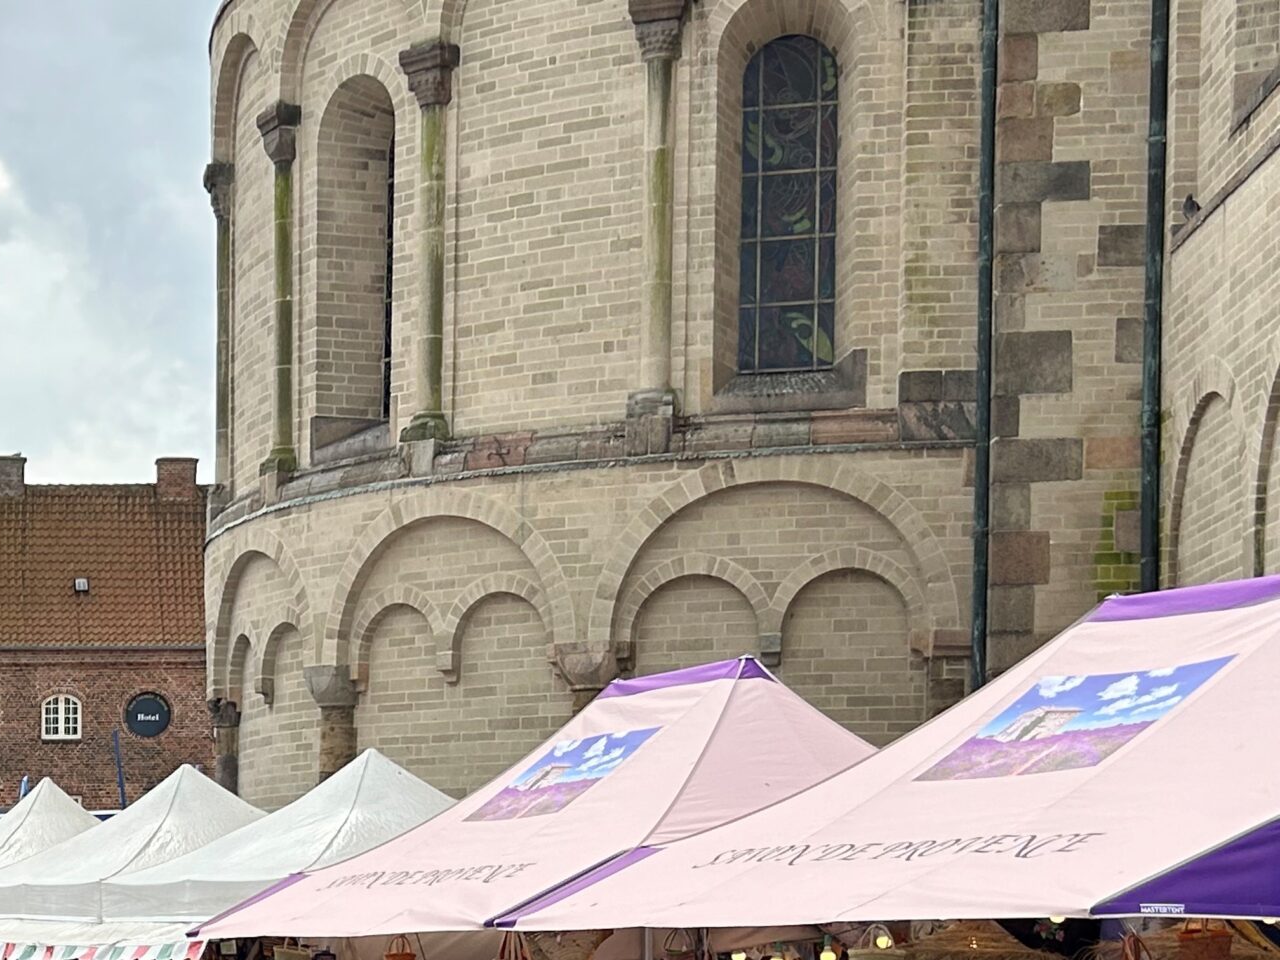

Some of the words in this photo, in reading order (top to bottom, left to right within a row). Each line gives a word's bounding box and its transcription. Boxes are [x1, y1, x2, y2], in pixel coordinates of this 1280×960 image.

[137, 713, 160, 721] Hotel
[810, 842, 885, 862] DE
[870, 832, 1106, 861] PROVENCE
